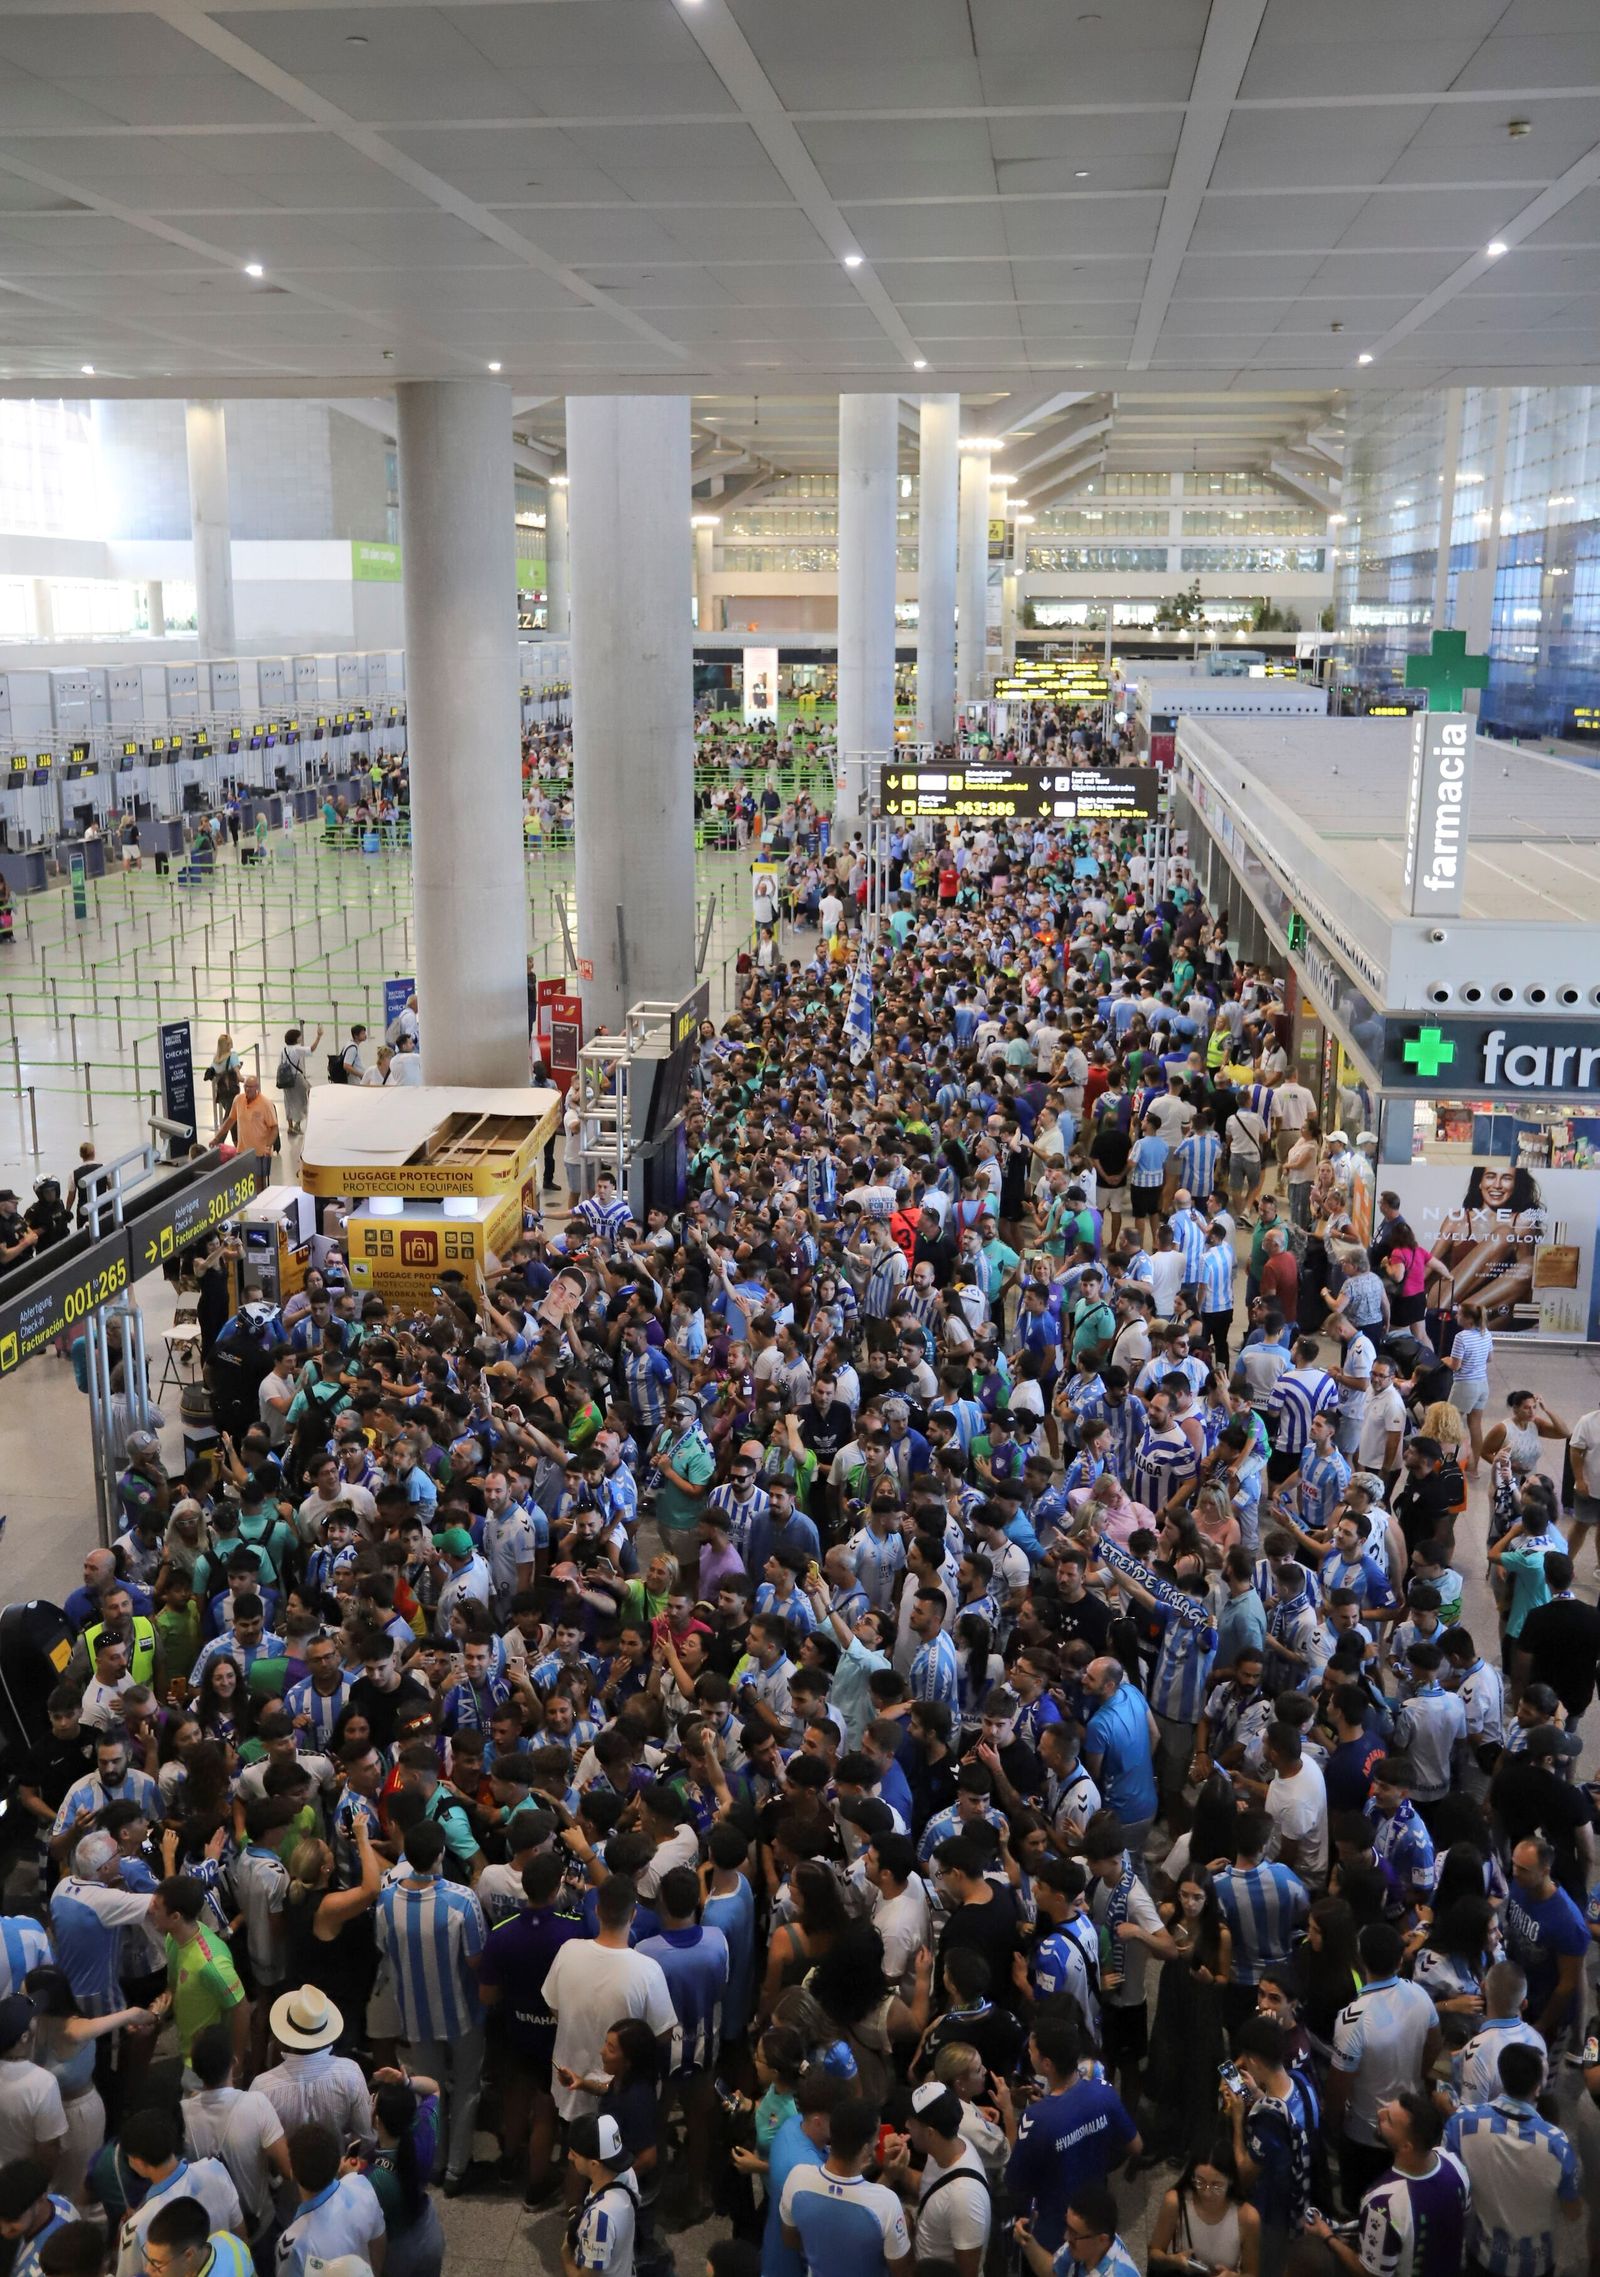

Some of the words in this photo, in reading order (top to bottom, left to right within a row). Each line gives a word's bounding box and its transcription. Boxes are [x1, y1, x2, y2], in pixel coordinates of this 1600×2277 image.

[955, 801, 982, 816] 363
[987, 801, 1015, 816] 386
[1424, 723, 1467, 892] farmacia
[165, 1048, 190, 1060] CHECK-IN
[342, 1172, 396, 1181] LUGGAGE
[400, 1172, 473, 1181] PROTECTION
[343, 1183, 415, 1192] PROTECCION
[420, 1183, 474, 1193] EQUIPAJES
[175, 1219, 208, 1248] Facturación
[208, 1190, 230, 1225] 301
[234, 1173, 255, 1207] 386
[1422, 1207, 1513, 1223] NUXE
[896, 1229, 911, 1250] 3
[1423, 1232, 1477, 1242] REVELA
[1484, 1234, 1500, 1242] TU
[1506, 1235, 1546, 1244] GLOW
[372, 1271, 412, 1279] LUGGAGE
[20, 1295, 53, 1324] Abfertigung
[21, 1317, 65, 1356] Facturación
[64, 1281, 94, 1323] 001
[99, 1257, 127, 1301] 265
[20, 1316, 45, 1339] Check-in
[1135, 1452, 1163, 1477] ALAGA
[1055, 2113, 1109, 2153] #VAMOSMALAGA
